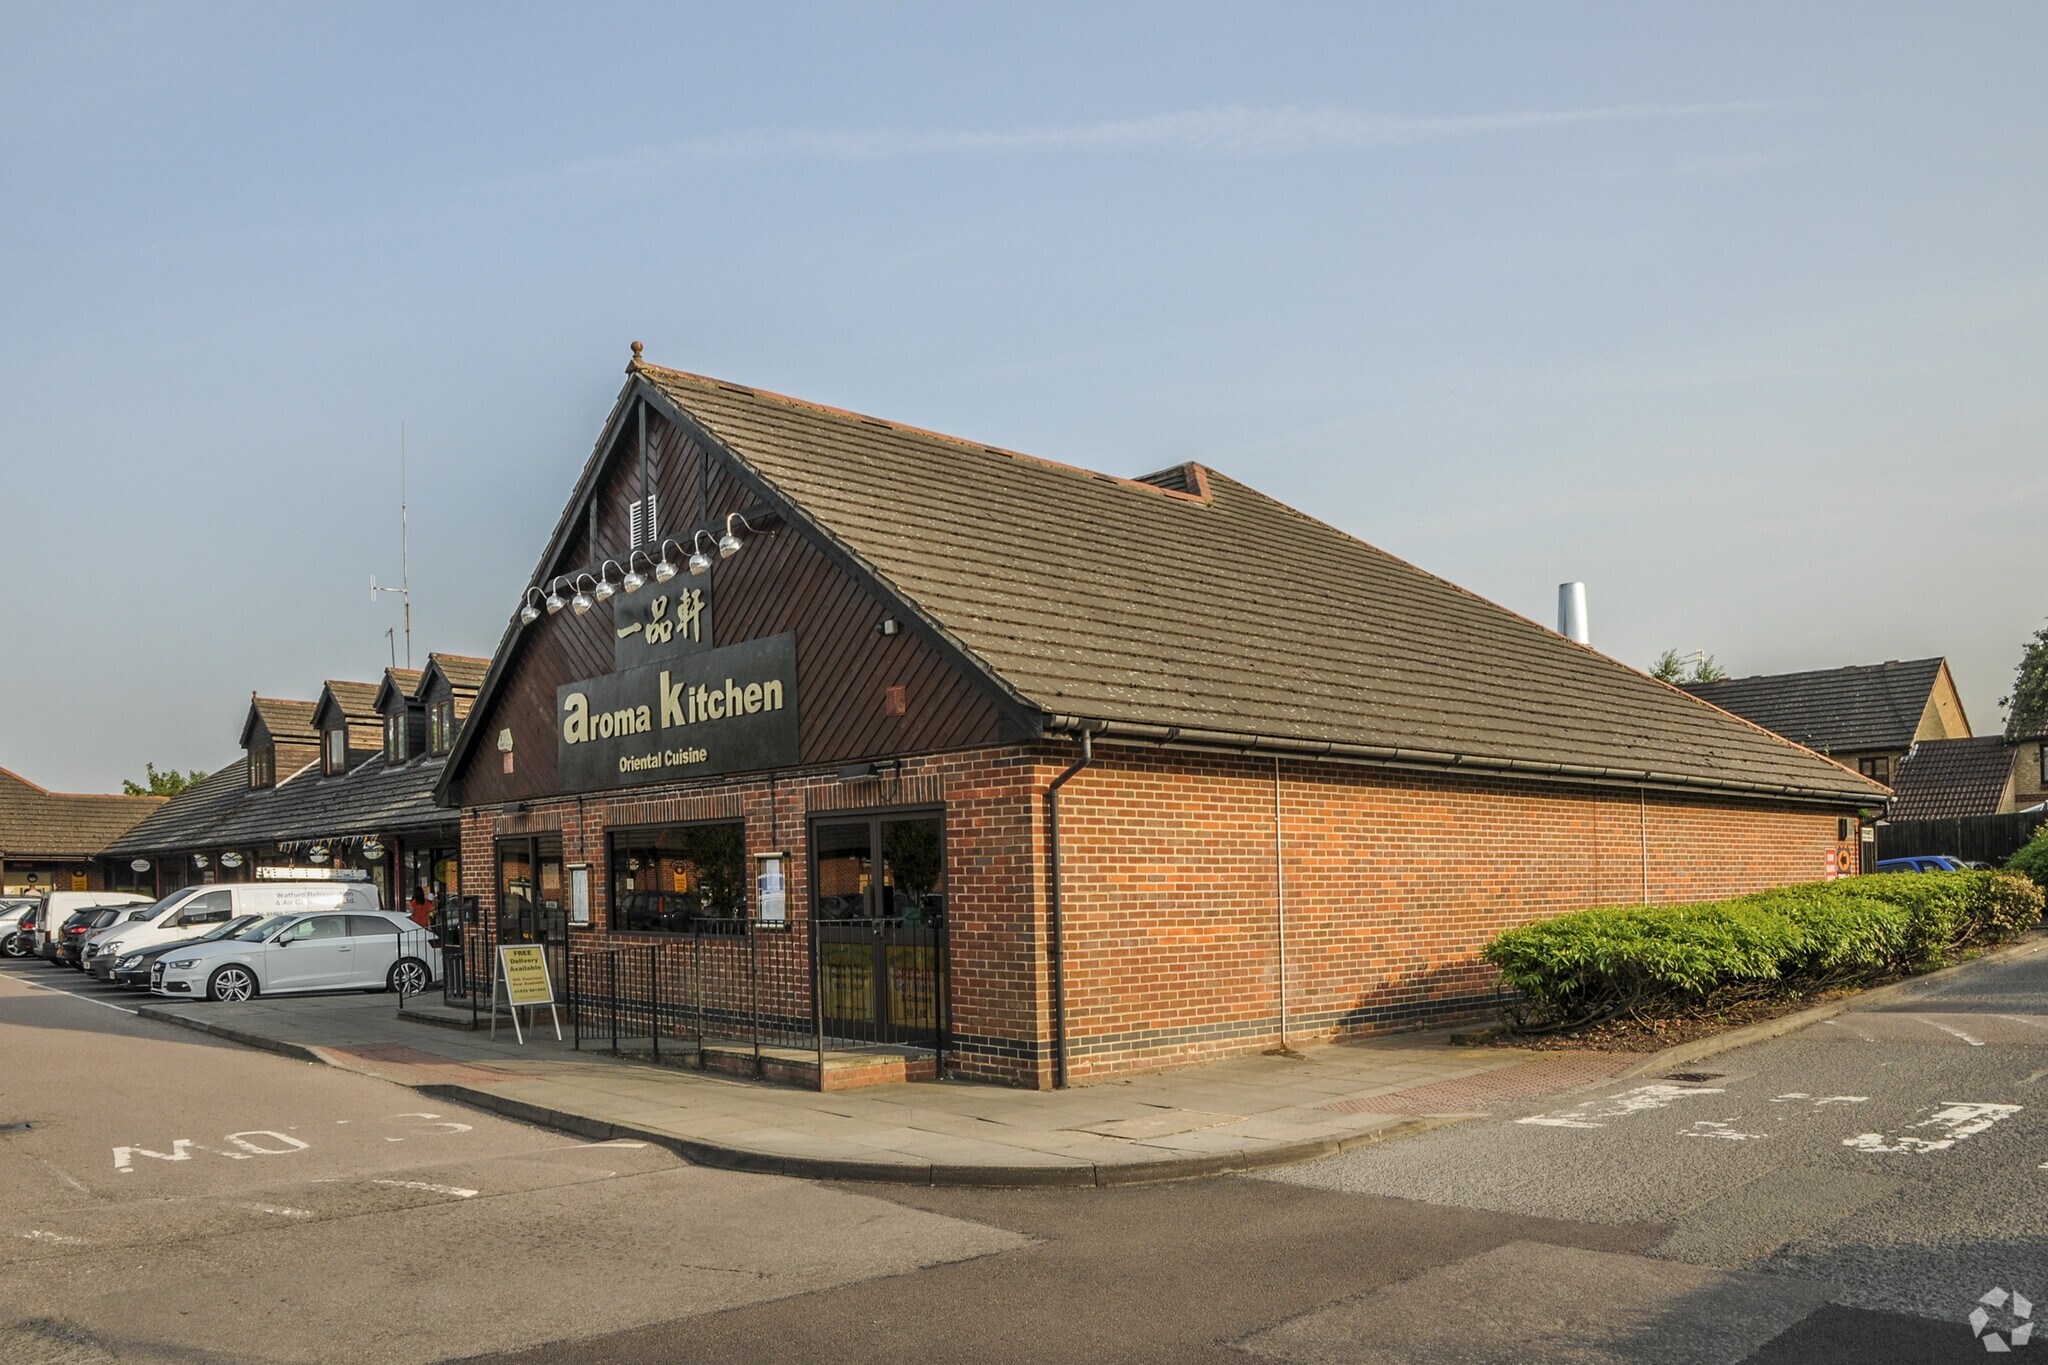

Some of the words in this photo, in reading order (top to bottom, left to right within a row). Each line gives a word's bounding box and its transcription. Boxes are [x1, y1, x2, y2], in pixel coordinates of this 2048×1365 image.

[563, 692, 651, 745] aroma
[619, 751, 662, 773] Oriental
[664, 747, 707, 767] Cuisine
